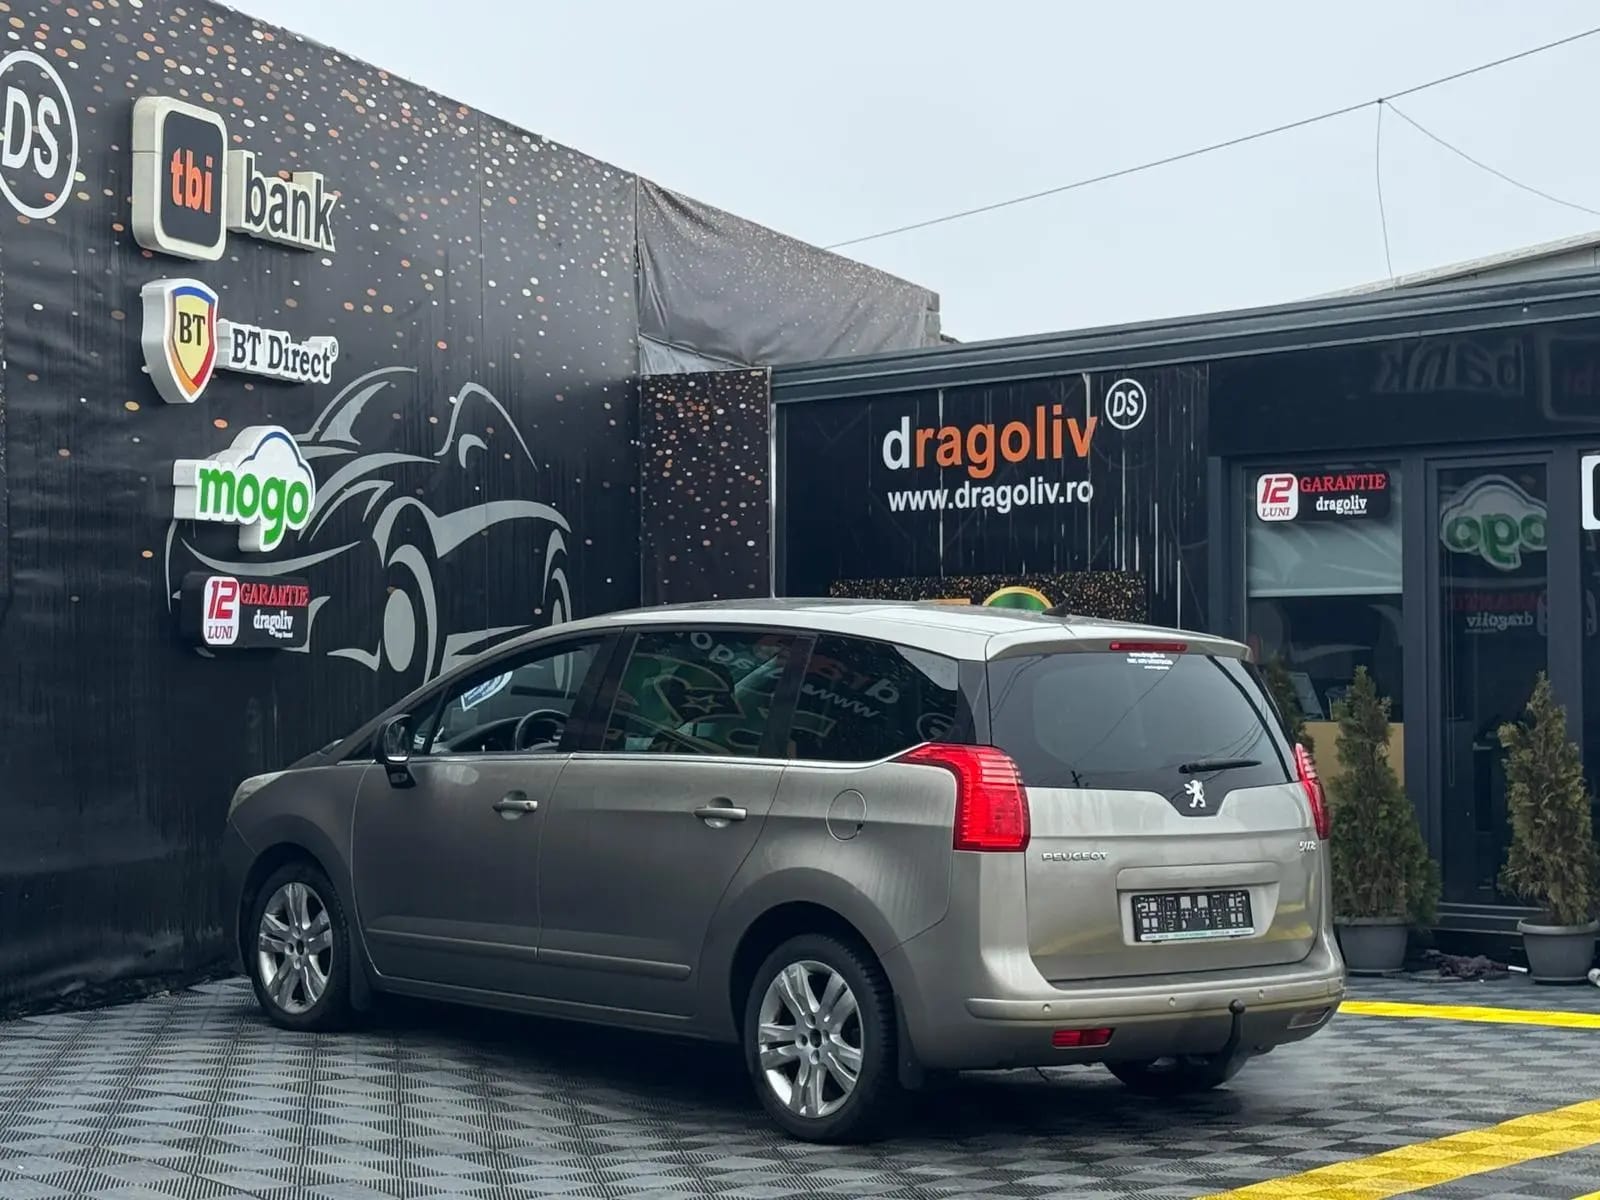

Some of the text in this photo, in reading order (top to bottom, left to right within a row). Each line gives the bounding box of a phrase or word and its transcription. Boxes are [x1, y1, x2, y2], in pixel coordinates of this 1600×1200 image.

[2, 86, 60, 179] DS
[170, 148, 336, 247] tbi bank
[178, 312, 205, 345] BT
[231, 328, 261, 365] BT
[1113, 390, 1139, 417] DS
[882, 404, 1098, 478] dragoliv
[199, 468, 308, 545] mogo
[888, 476, 1094, 514] www.dragoliv.ro
[1261, 473, 1386, 503] 12 GARANTIE
[1261, 495, 1367, 517] LUNI dragoliv
[208, 581, 309, 619] 12 GARANTIE
[208, 609, 293, 639] LUNI dragoliv
[1042, 851, 1108, 861] PEUGEOT
